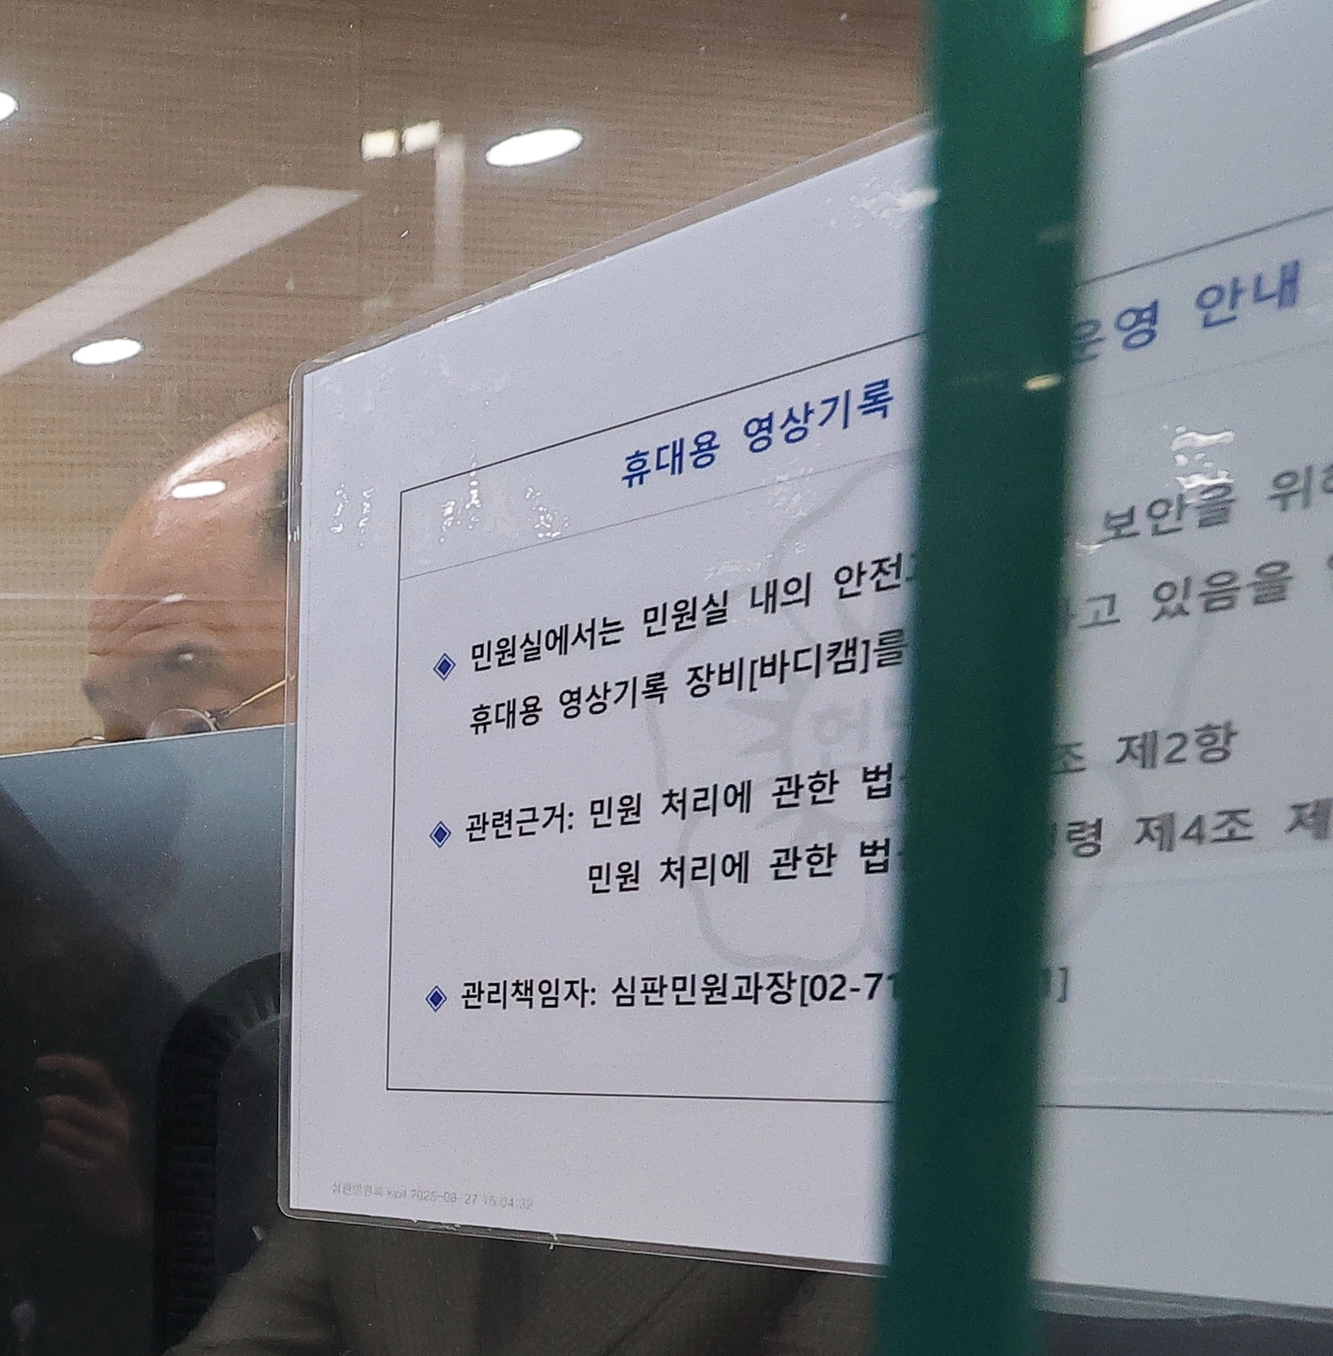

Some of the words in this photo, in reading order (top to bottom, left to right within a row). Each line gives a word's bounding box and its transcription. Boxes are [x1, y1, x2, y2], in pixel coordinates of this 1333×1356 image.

[621, 430, 720, 488] 휴대용
[743, 378, 894, 454] 영상기록
[1195, 259, 1301, 328] 안내
[470, 696, 543, 735] 휴대용
[558, 671, 668, 721] 영상기록
[685, 628, 907, 699] 장비[바디캠]를
[1070, 592, 1121, 629] 고
[1152, 560, 1294, 622] 있음을
[471, 617, 625, 673] 민원실에서는
[642, 591, 729, 633] 민원실
[750, 572, 812, 615] 내의
[1100, 485, 1236, 542] 보안을
[465, 802, 575, 843] 관련근거:
[590, 792, 642, 829] 민원
[661, 779, 752, 824] 처리에
[771, 769, 839, 808] 관한
[862, 762, 905, 799] 법
[1116, 721, 1238, 769] 제2항
[588, 860, 641, 894] 민원
[659, 850, 750, 889] 처리에
[770, 842, 837, 880] 관한
[859, 837, 903, 874] 법
[1054, 817, 1103, 858] 령
[1135, 808, 1253, 852] 제4조
[460, 977, 597, 1010] 관리책임자:
